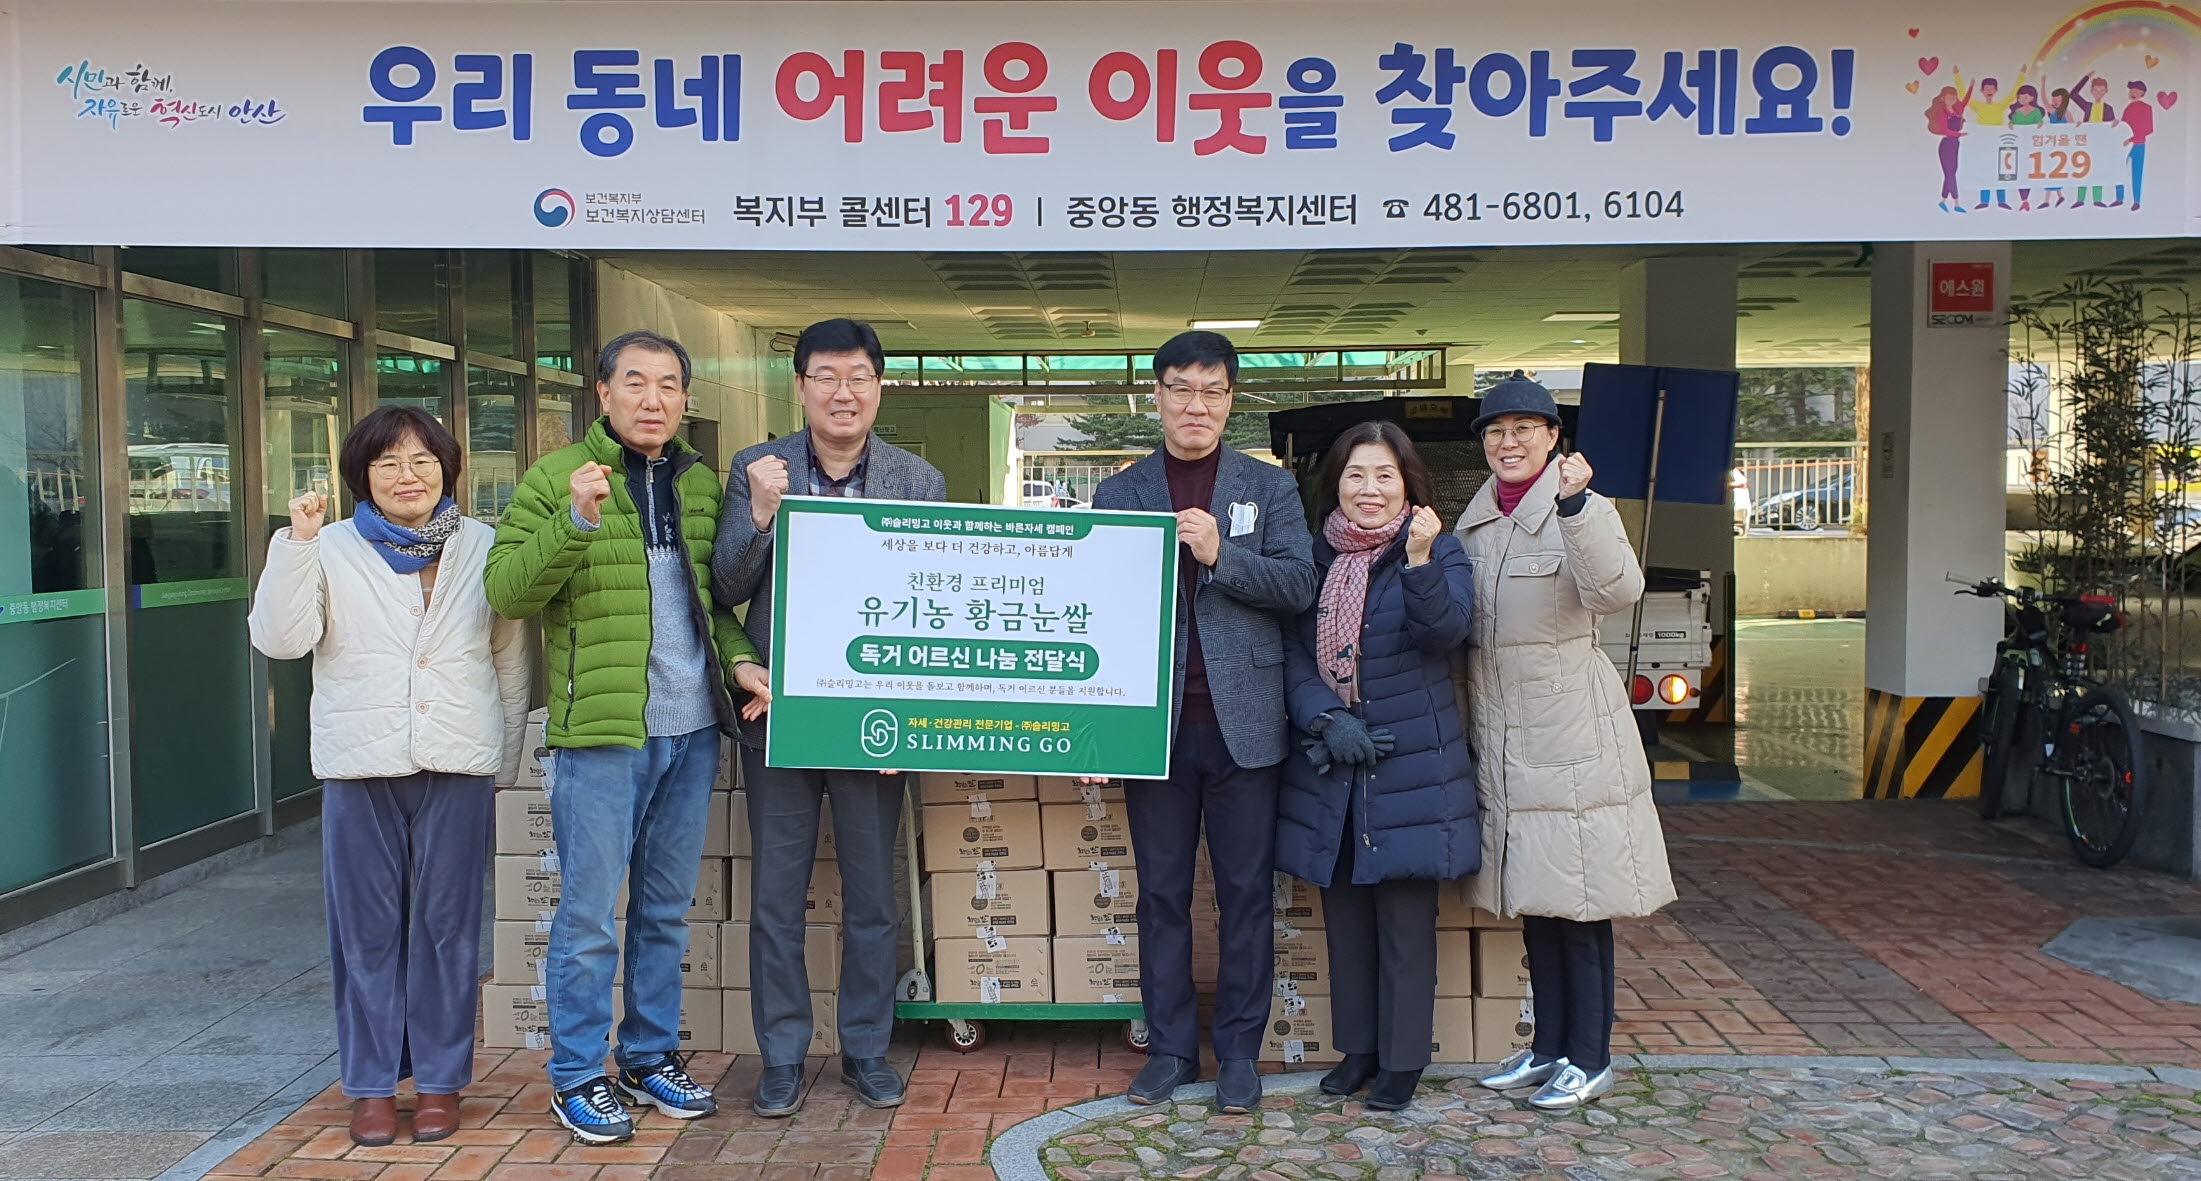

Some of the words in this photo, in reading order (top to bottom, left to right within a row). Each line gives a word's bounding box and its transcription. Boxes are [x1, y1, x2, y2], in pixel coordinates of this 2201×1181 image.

[57, 60, 125, 99] 시민과
[361, 46, 533, 147] 우리
[566, 50, 742, 159] 동네
[776, 42, 1058, 155] 어려운
[1089, 41, 1344, 156] 이웃을
[1376, 42, 1854, 153] 찾아주세요!
[78, 98, 142, 130] 자유로운
[150, 98, 221, 129] 혁신도시
[229, 98, 286, 124] 안산
[2028, 150, 2091, 179] 129
[586, 193, 642, 204] 보건복지부
[586, 209, 705, 224] 보건복지상담센터
[734, 196, 826, 227] 복지부
[840, 197, 930, 228] 콜센터
[945, 194, 1013, 227] 129
[1067, 197, 1159, 228] 중앙동
[1172, 194, 1357, 227] 행정복지센터
[1424, 192, 1590, 222] 481-6801,
[1605, 191, 1684, 218] 6104
[1940, 279, 1984, 297] 에스원
[933, 519, 961, 531] 이웃과
[965, 520, 1002, 532] 함께하는
[1005, 522, 1043, 534] 바른자세
[1046, 524, 1074, 536] 캠페인
[881, 538, 918, 552] 세상을
[922, 540, 947, 553] 보다
[952, 541, 963, 554] 더
[968, 542, 1020, 557] 건강하고,
[1024, 544, 1073, 558] 아름답게
[907, 572, 962, 593] 친환경
[969, 575, 1045, 596] 프리미엄
[9, 601, 29, 616] 중앙동
[857, 596, 954, 630] 유기농
[964, 598, 1093, 634] 황금눈쌀
[859, 643, 902, 666] 독거
[908, 644, 970, 669] 어르신
[976, 646, 1018, 671] 나눔
[1024, 648, 1086, 673] 전달식
[875, 680, 893, 690] 우리
[896, 680, 924, 691] 이웃을
[927, 681, 954, 691] 돌보고
[957, 682, 995, 693] 함께하며,
[997, 683, 1016, 693] 독거
[1019, 684, 1045, 694] 어르신
[1048, 685, 1076, 695] 분들을
[1078, 686, 1126, 697] 지원합니다.
[975, 719, 1013, 731] 전문기업
[907, 733, 1031, 752] SLIMMING
[1039, 737, 1071, 753] GO
